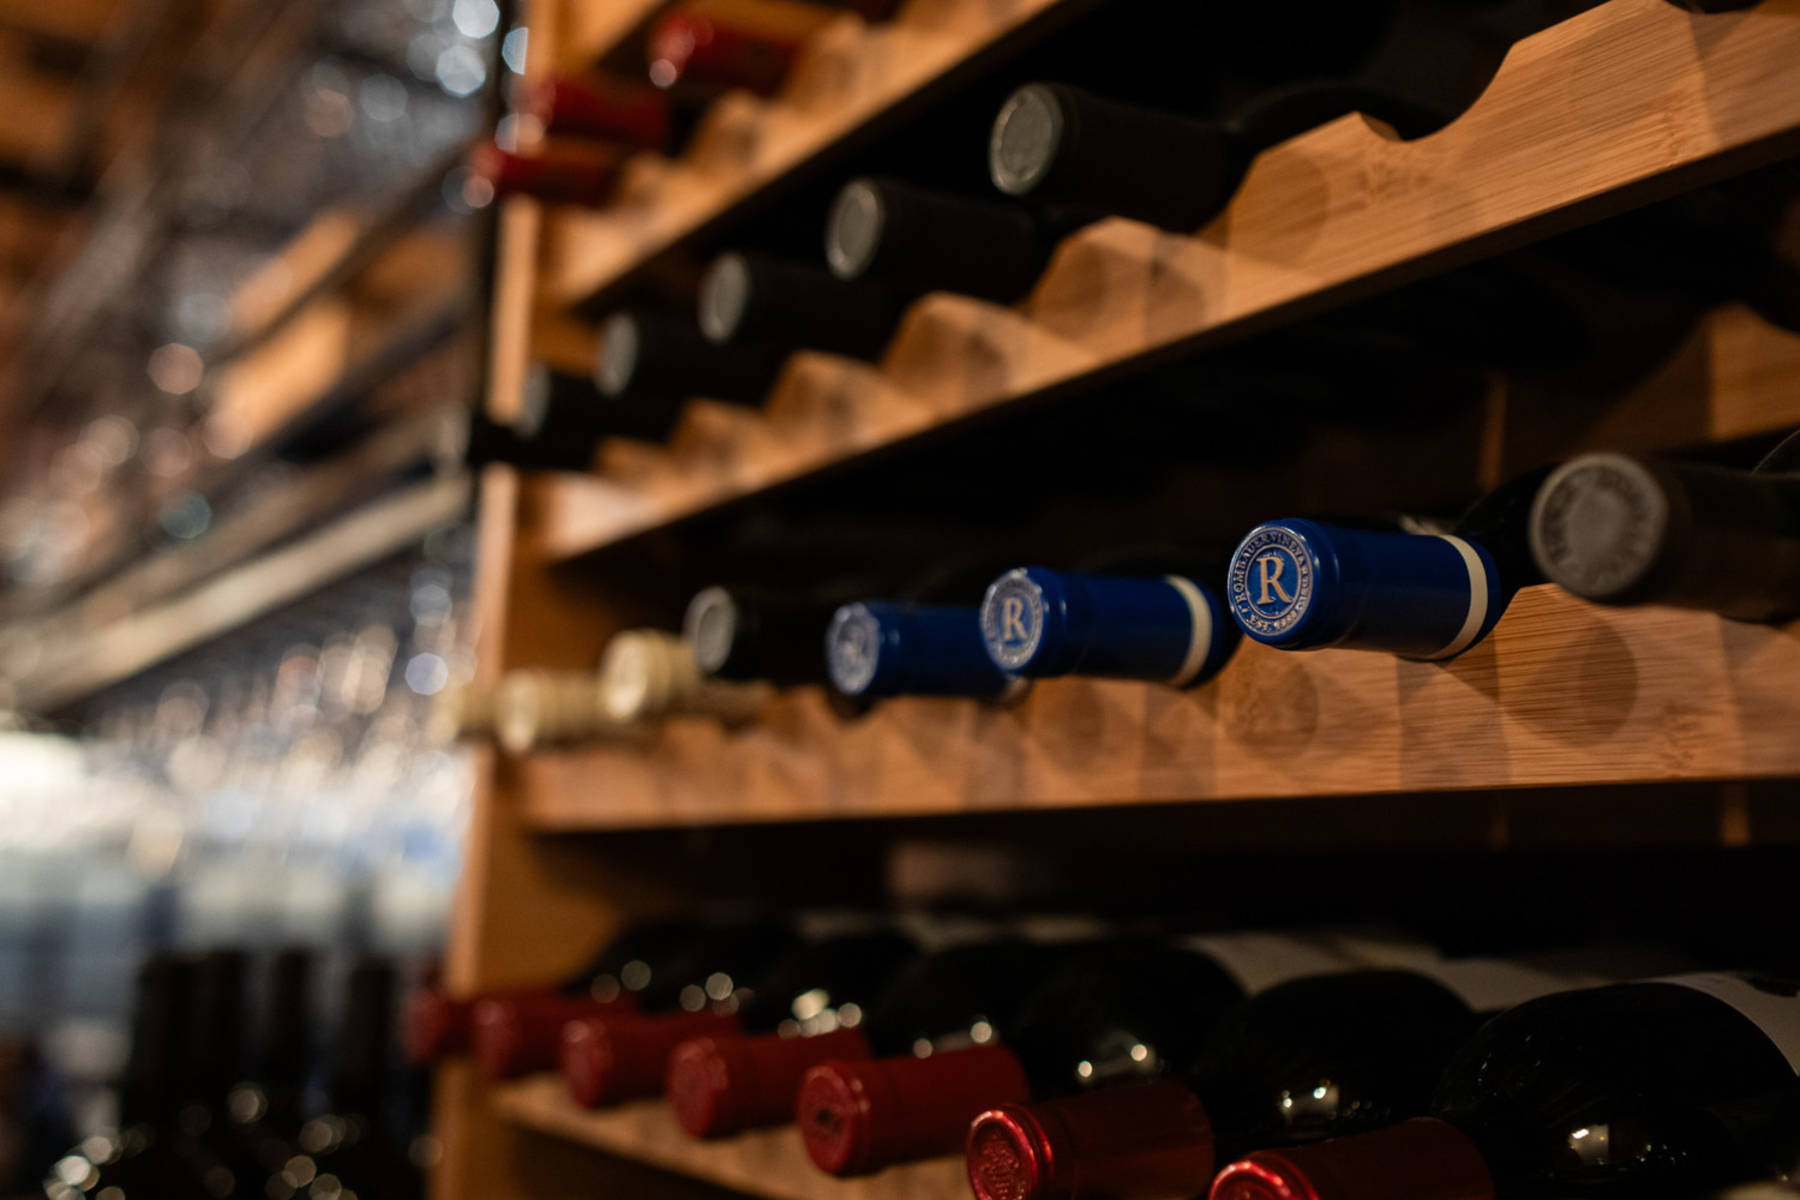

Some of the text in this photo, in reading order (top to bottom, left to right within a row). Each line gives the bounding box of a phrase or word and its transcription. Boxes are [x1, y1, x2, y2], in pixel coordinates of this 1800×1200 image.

[1233, 533, 1270, 602] ROMBAUER
[1256, 556, 1293, 605] R
[1003, 597, 1028, 639] R
